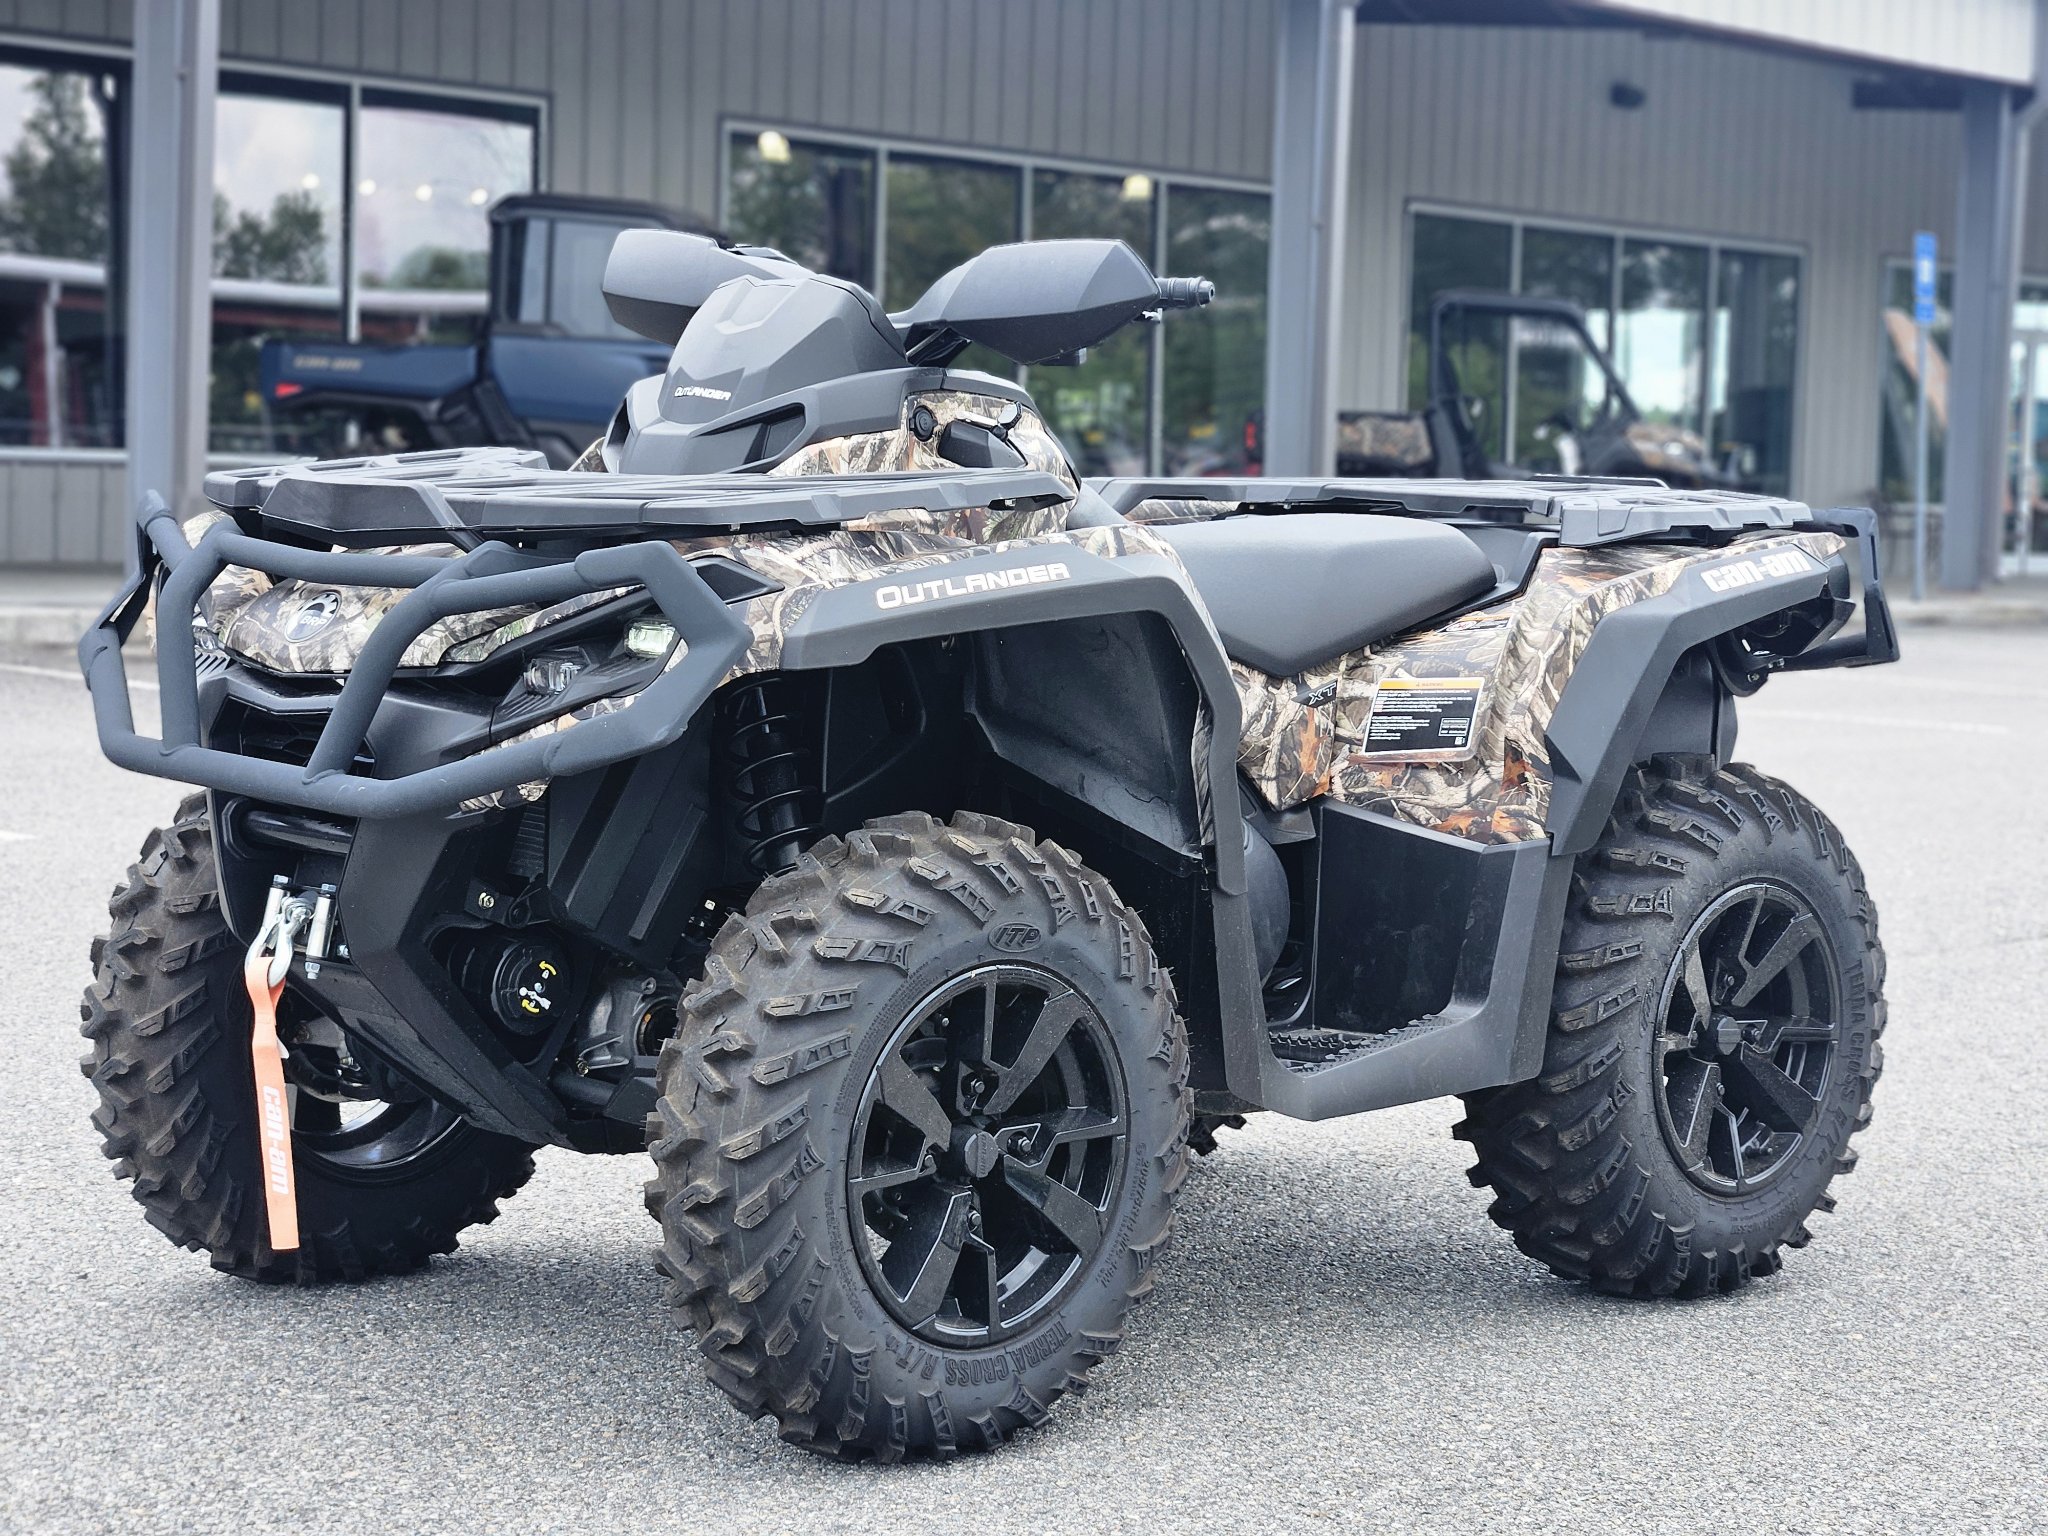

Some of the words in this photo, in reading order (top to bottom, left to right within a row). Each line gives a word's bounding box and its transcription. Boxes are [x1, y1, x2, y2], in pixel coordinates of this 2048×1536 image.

[675, 386, 732, 401] OUTLANDER
[876, 562, 1071, 610] OUTLANDER
[1700, 550, 1813, 592] can-am
[301, 615, 328, 626] BRP
[1309, 682, 1337, 705] XT
[994, 926, 1041, 948] ITP
[263, 1085, 289, 1195] can-am
[1010, 1320, 1073, 1375] TERRA
[944, 1353, 1011, 1387] CROSS
